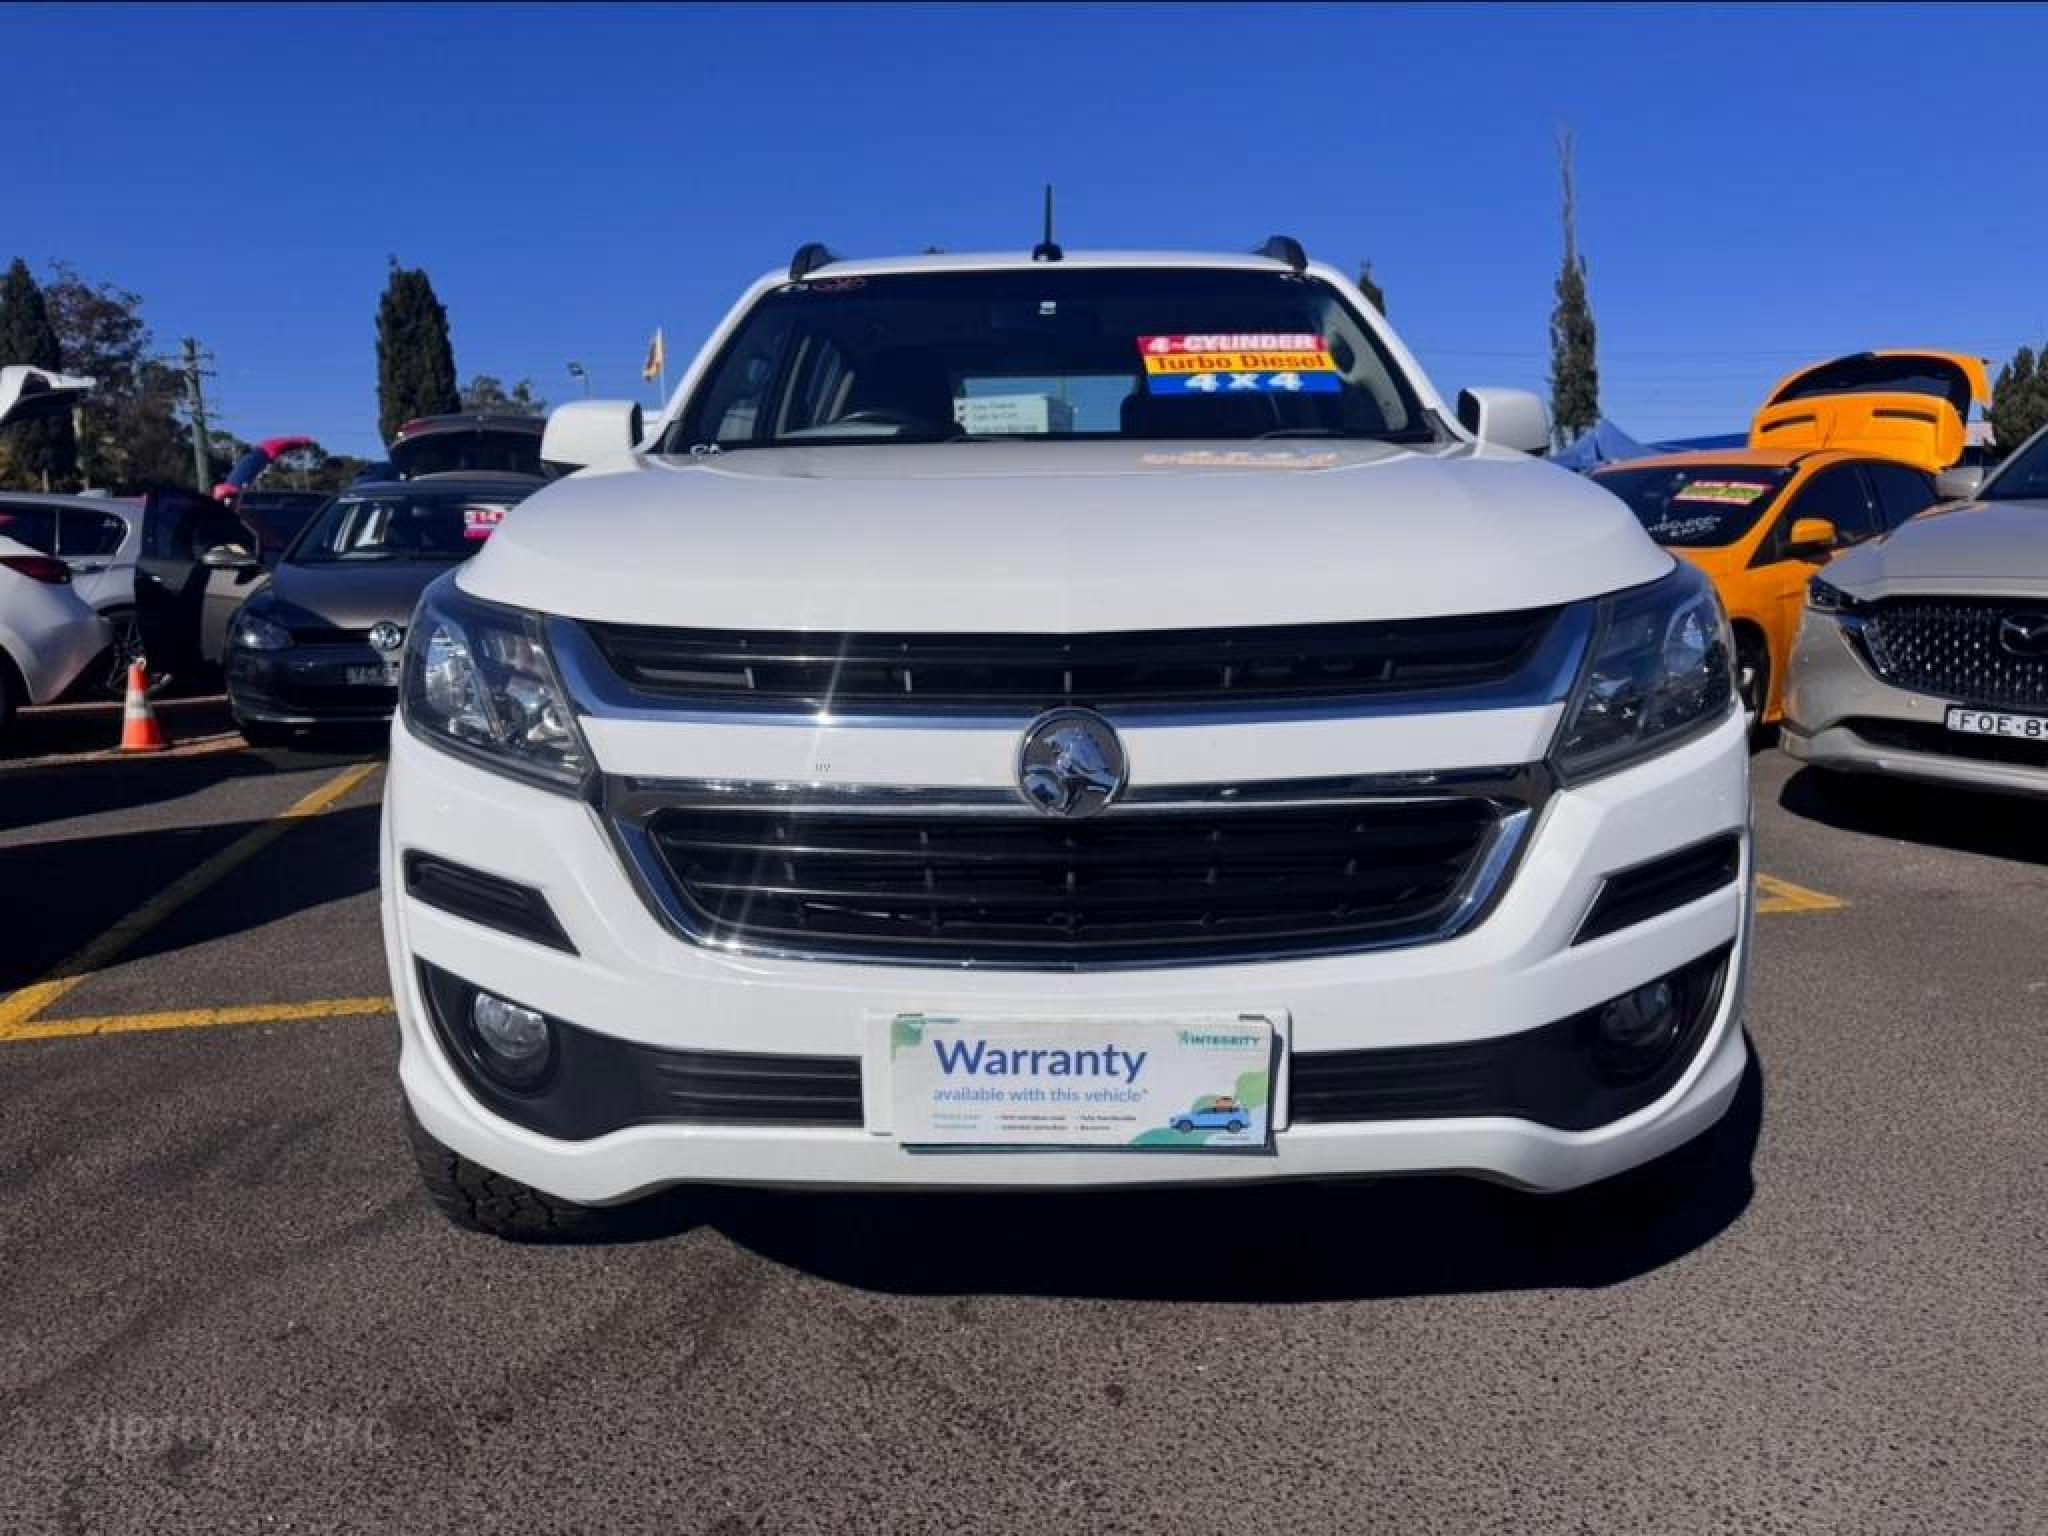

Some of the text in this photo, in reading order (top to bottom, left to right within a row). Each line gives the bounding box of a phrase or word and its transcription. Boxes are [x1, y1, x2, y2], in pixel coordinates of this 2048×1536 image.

[1151, 353, 1327, 370] Turbo Diesel
[1184, 373, 1218, 392] 4
[1267, 372, 1303, 392] 4
[933, 1039, 1148, 1084] Warranty
[934, 1088, 1005, 1103] available
[1008, 1088, 1046, 1102] with
[1050, 1088, 1080, 1102] this
